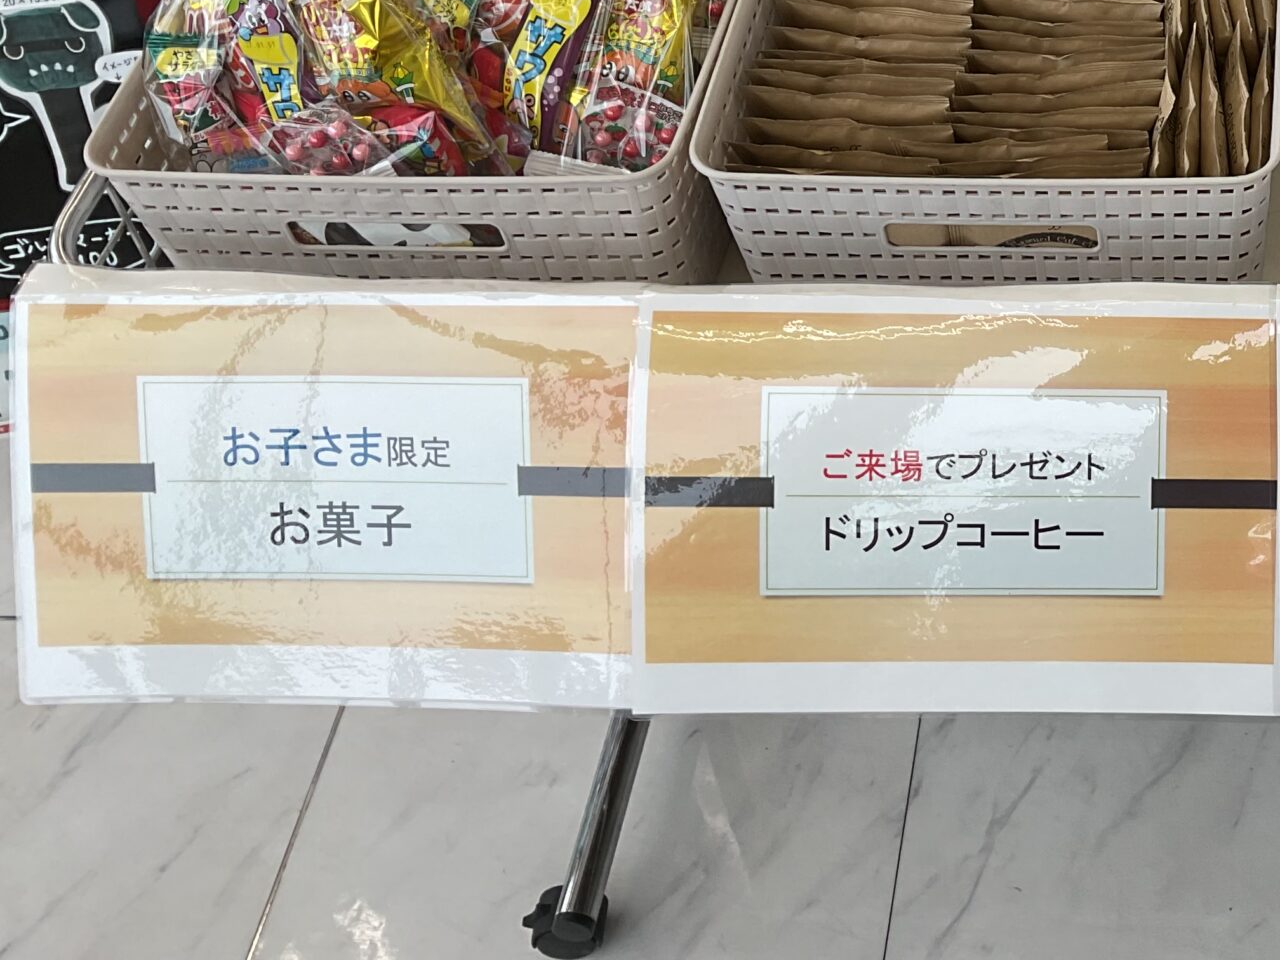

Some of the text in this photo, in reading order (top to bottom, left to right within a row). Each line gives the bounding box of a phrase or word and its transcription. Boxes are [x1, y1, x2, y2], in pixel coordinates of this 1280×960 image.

[222, 425, 452, 469] お子さま限定
[822, 447, 1106, 483] ご来場でプレゼント
[269, 500, 413, 549] お菓子
[823, 511, 1106, 553] ドリップコーヒー
